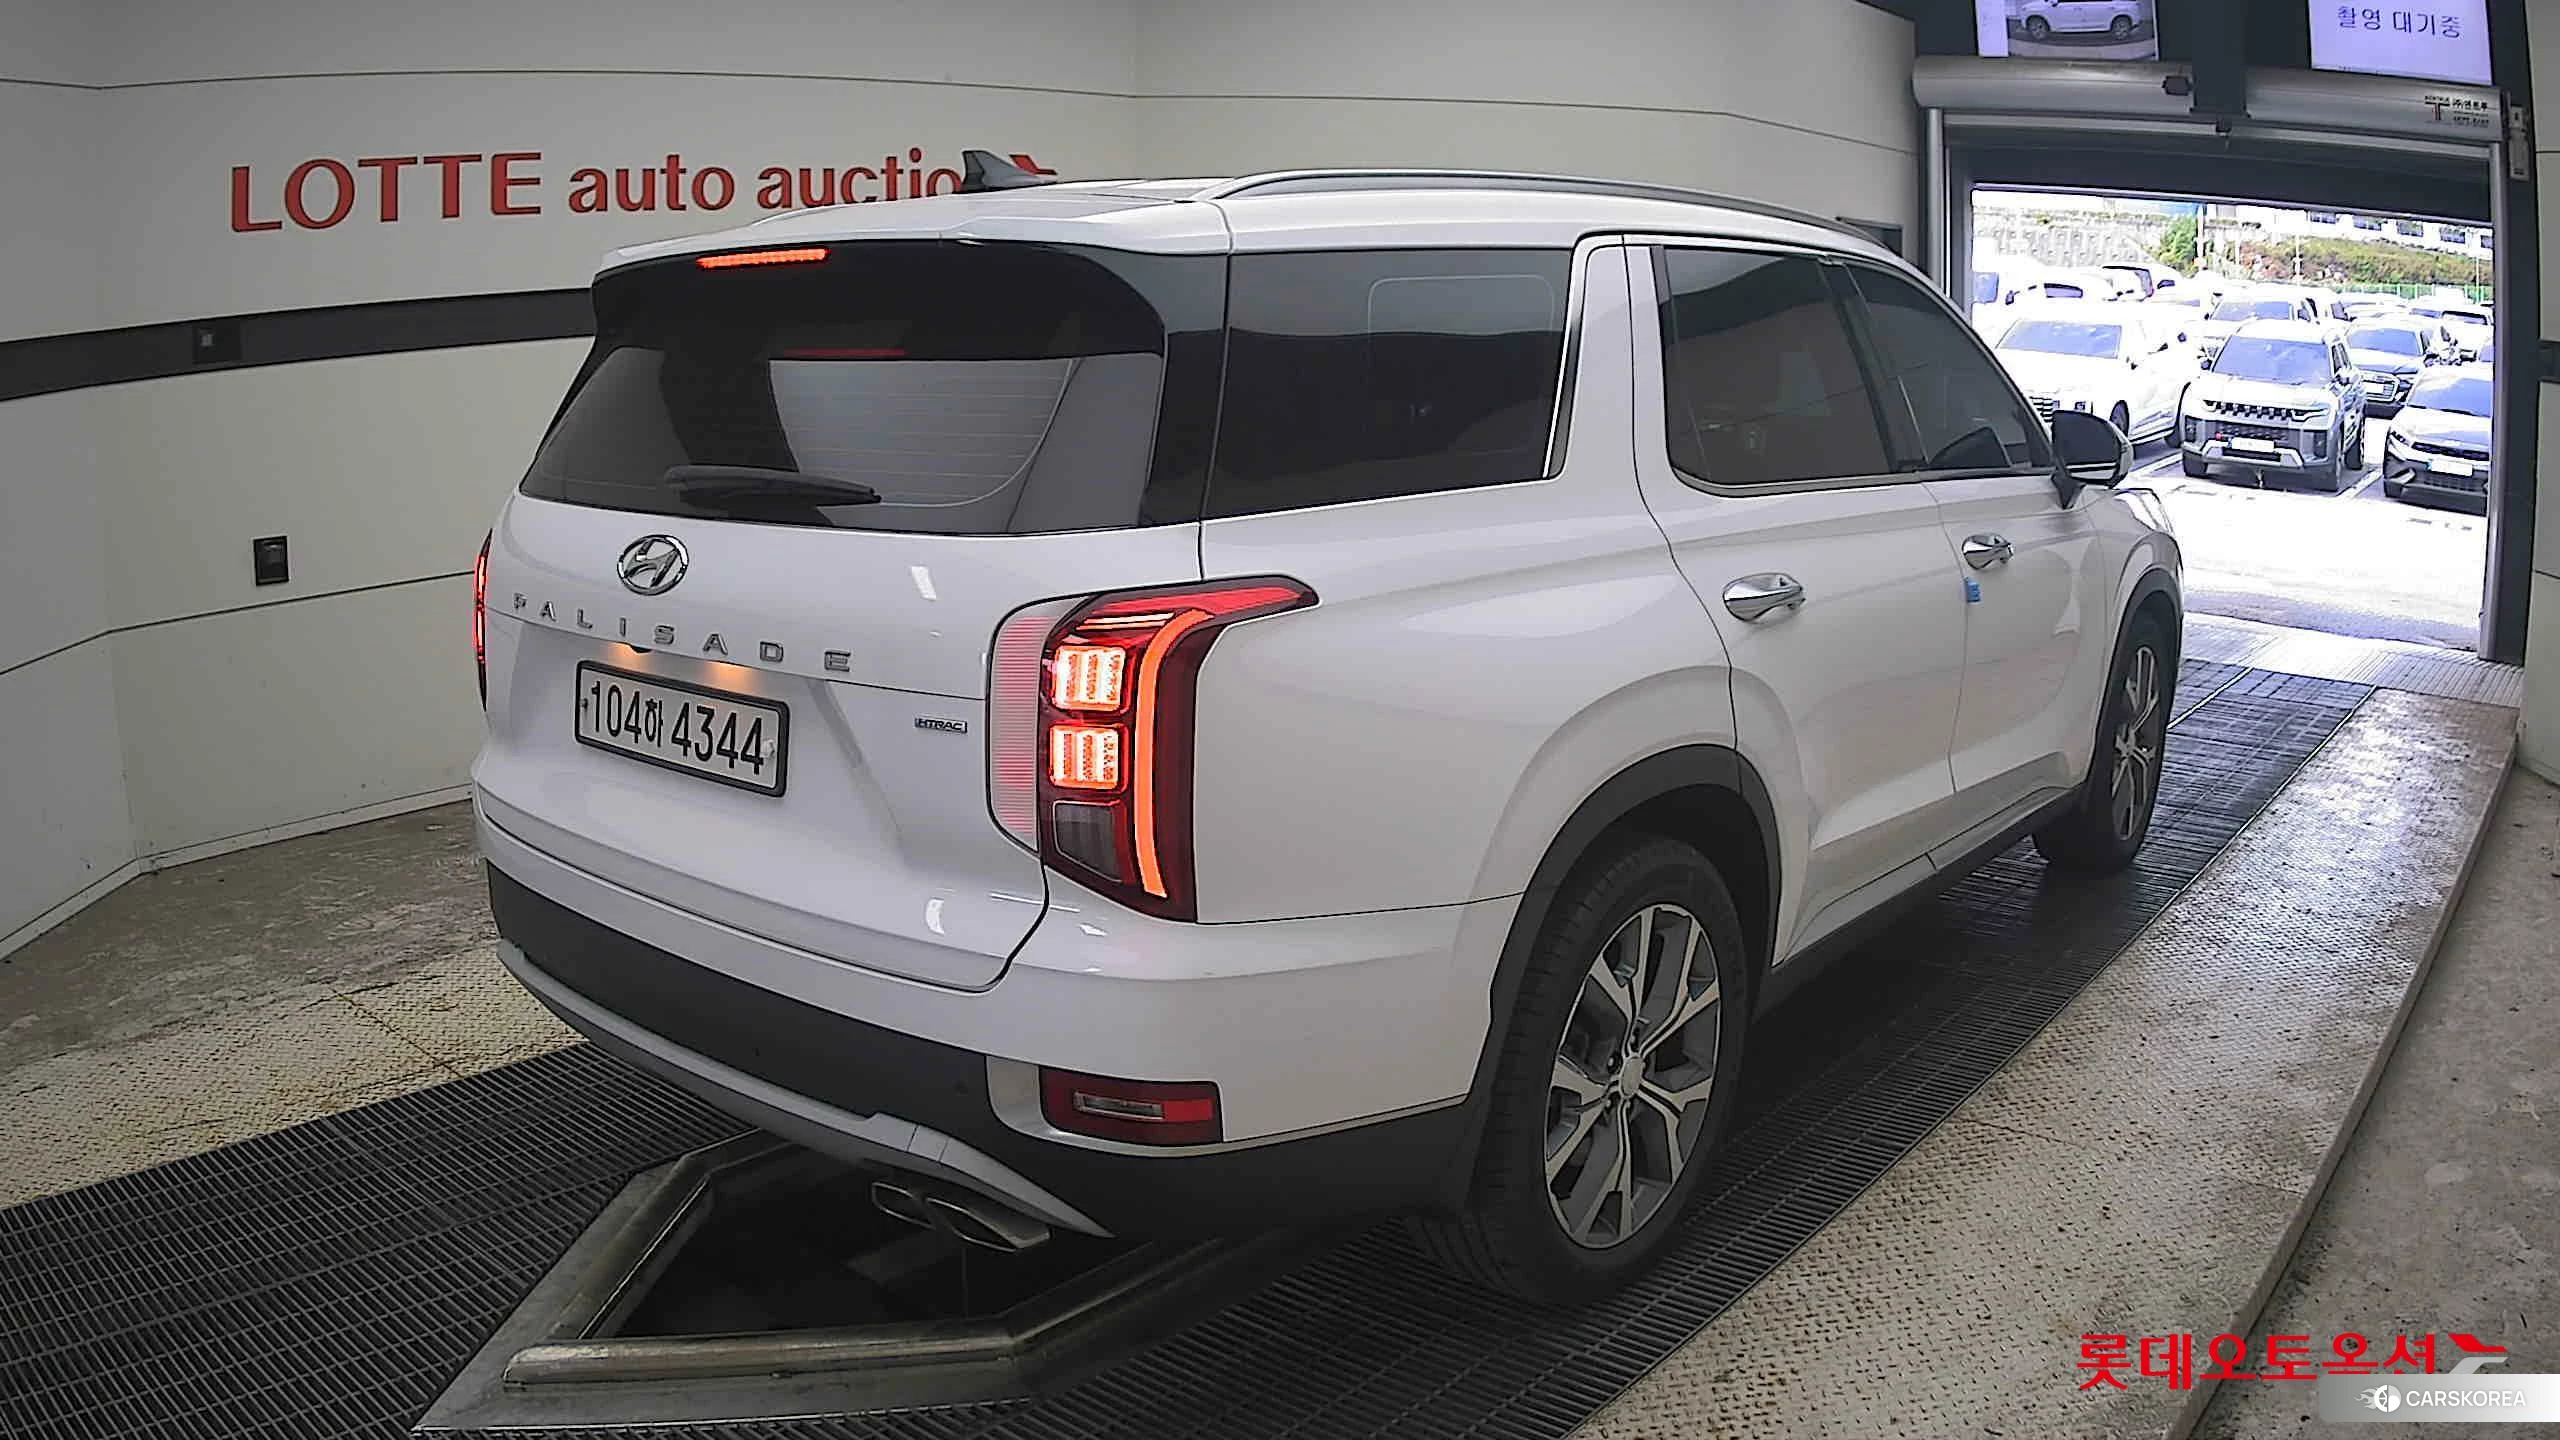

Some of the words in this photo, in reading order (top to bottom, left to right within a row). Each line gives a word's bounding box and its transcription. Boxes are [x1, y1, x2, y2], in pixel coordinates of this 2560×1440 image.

[2338, 6, 2382, 31] 촬영
[2392, 10, 2463, 39] 대기중
[230, 151, 543, 233] LOTTE
[568, 154, 735, 213] auto
[756, 147, 963, 210] auctio
[513, 592, 852, 674] PALISADE
[591, 680, 665, 749] 104하
[671, 702, 765, 776] 4344
[917, 718, 964, 732] HTRAC
